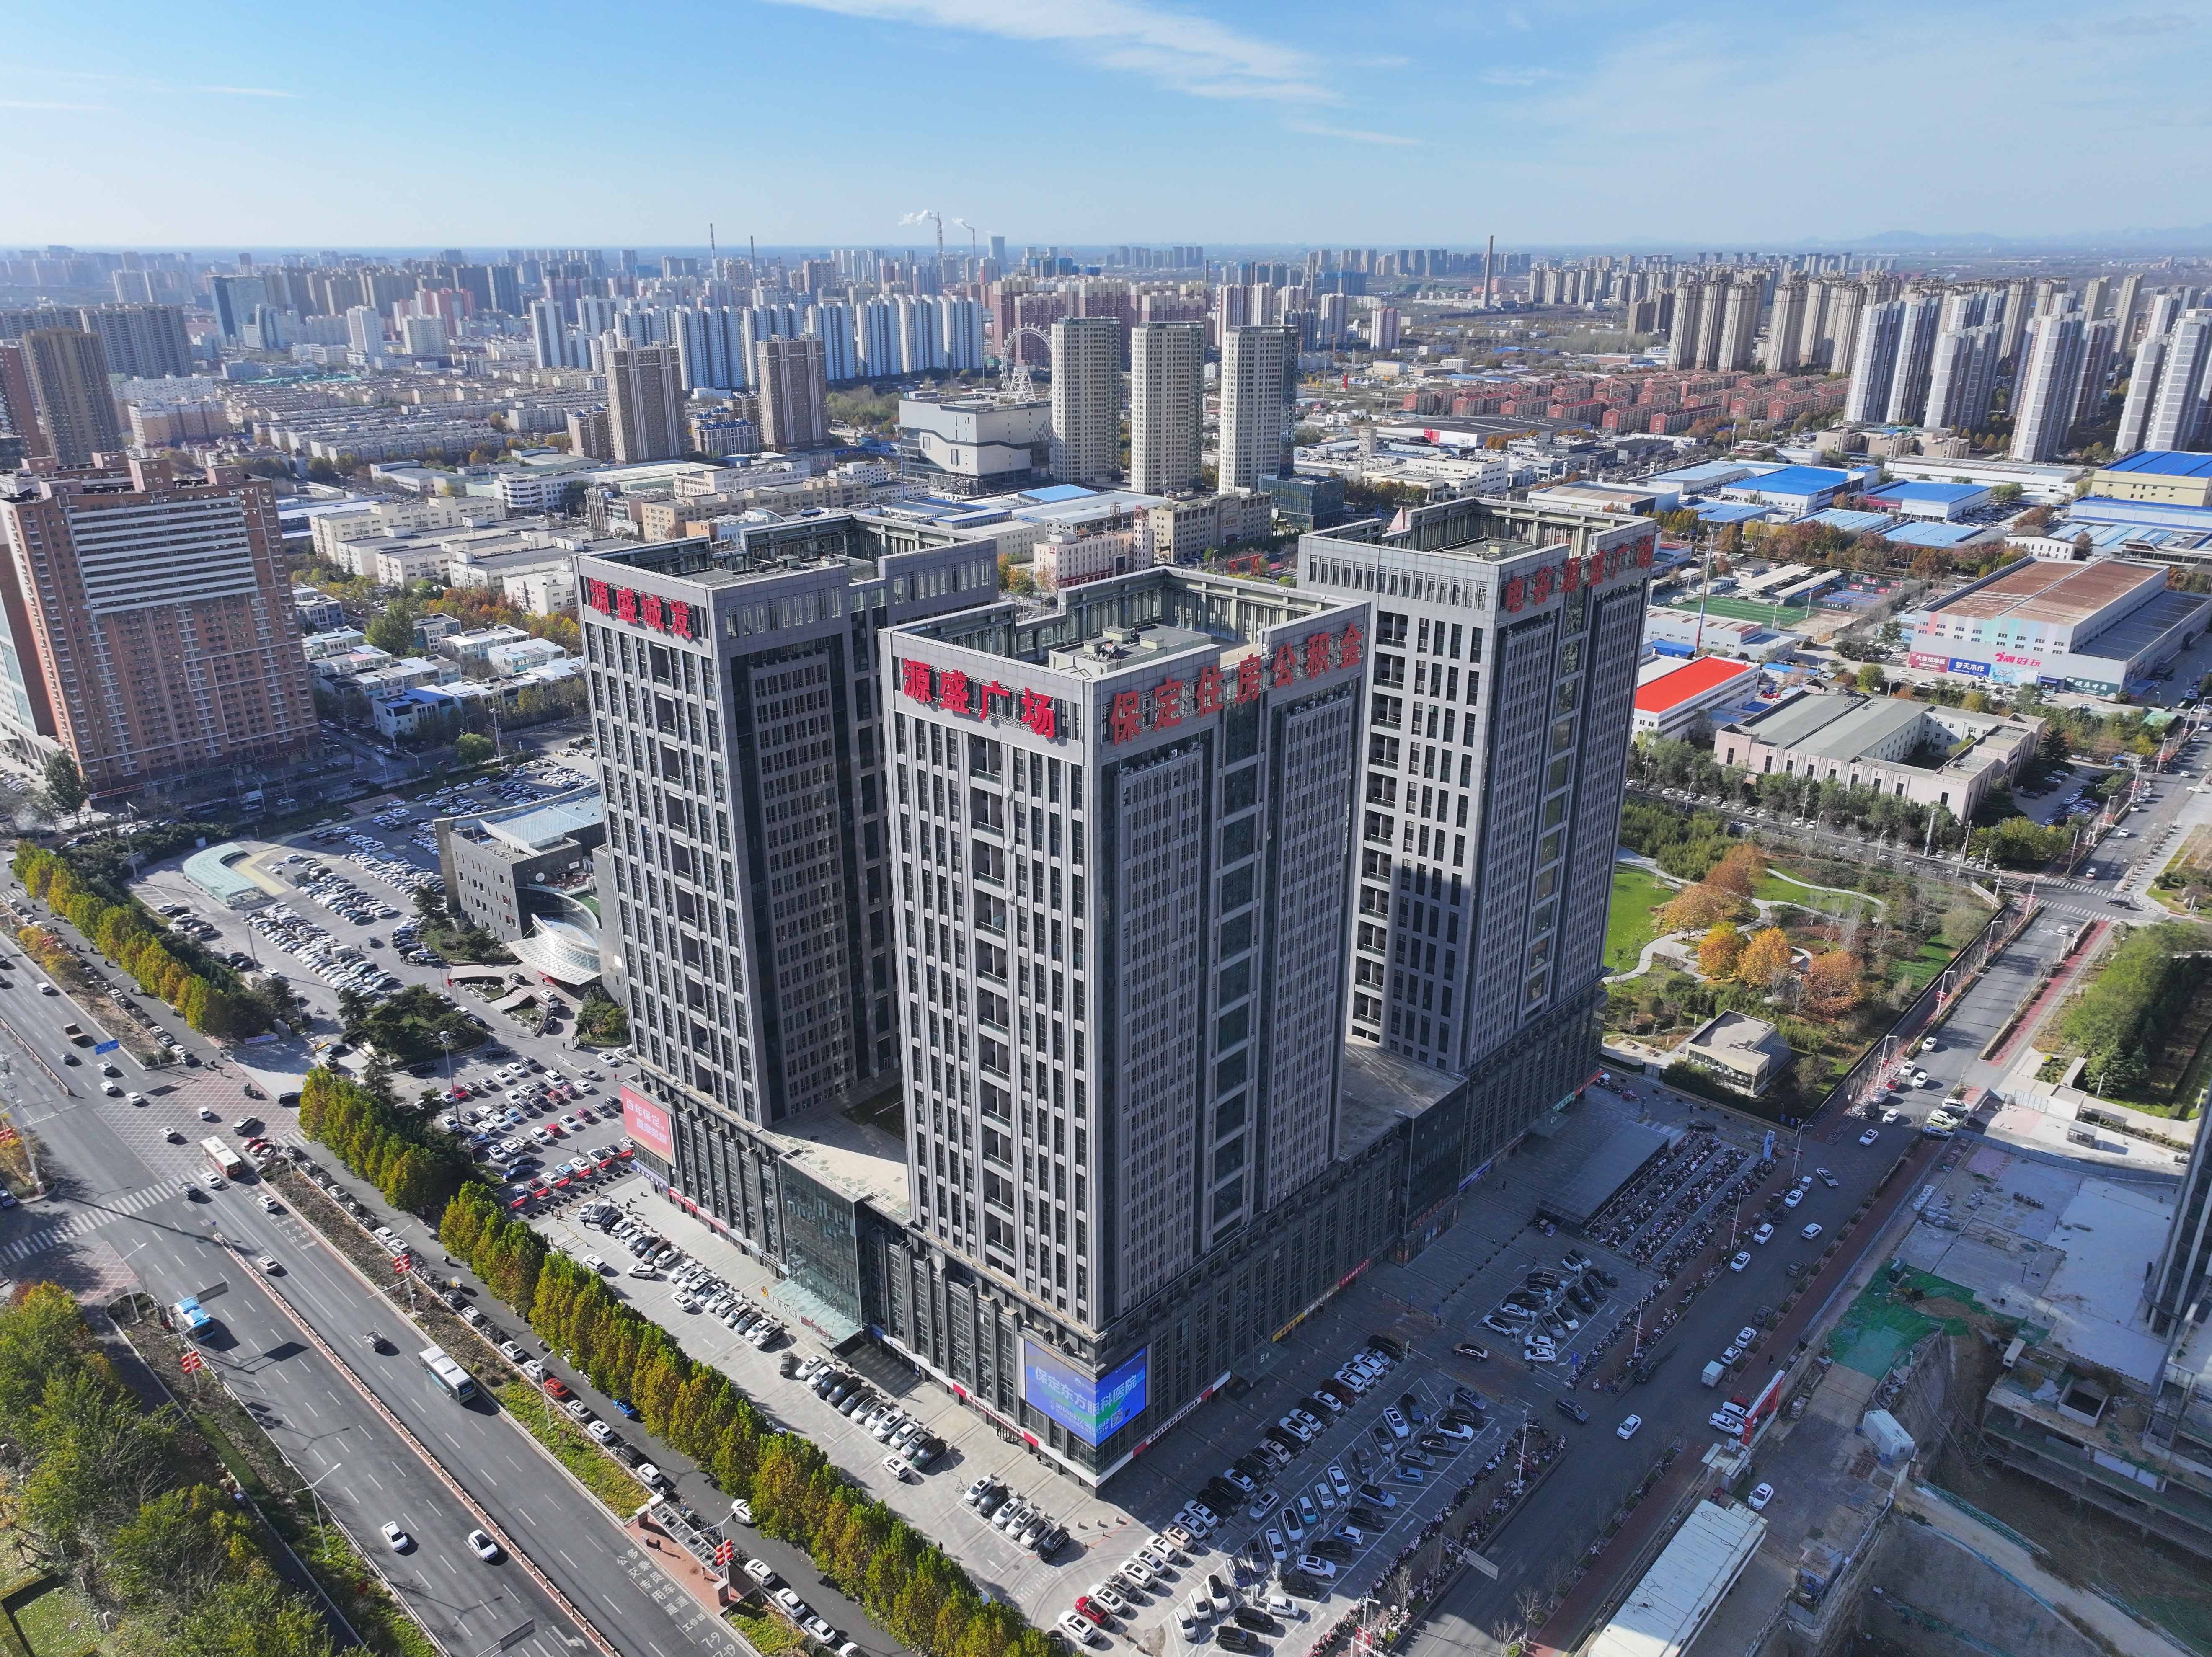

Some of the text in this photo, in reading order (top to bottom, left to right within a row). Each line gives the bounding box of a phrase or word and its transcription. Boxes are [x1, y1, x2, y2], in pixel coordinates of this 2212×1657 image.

[1506, 536, 1654, 613] 电谷源盛广场
[589, 577, 693, 640] 源盛城发
[1916, 655, 1946, 664] 大自然地板
[1955, 661, 1985, 672] 梦天木作
[904, 658, 1054, 738] 源盛广场
[1110, 623, 1362, 746] 保定住房公积金
[626, 1098, 661, 1128] 百年保定
[283, 1226, 302, 1235] 7-9
[289, 1231, 310, 1243] 17-19
[1035, 1366, 1137, 1416] 保定东方眼科医院
[617, 1556, 679, 1616] 公交专用道
[682, 1613, 706, 1632] 工作日
[701, 1632, 720, 1648] 7-9
